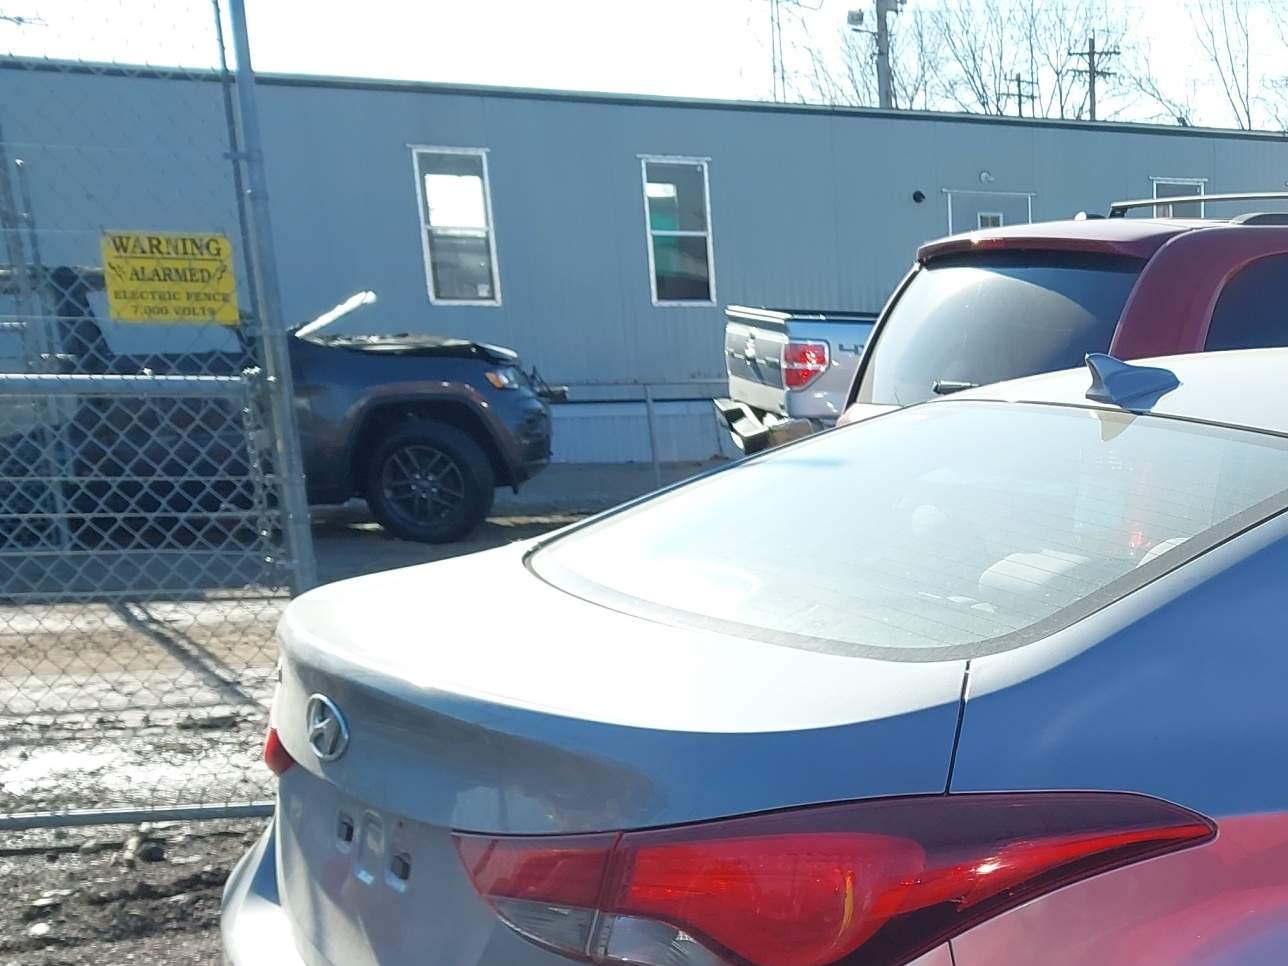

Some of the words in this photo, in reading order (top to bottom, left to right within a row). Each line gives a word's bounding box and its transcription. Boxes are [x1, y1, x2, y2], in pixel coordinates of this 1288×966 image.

[111, 236, 221, 256] WARNING
[130, 266, 211, 283] ALARMED
[114, 291, 181, 301] ELECTRIC
[187, 292, 230, 302] FENCE
